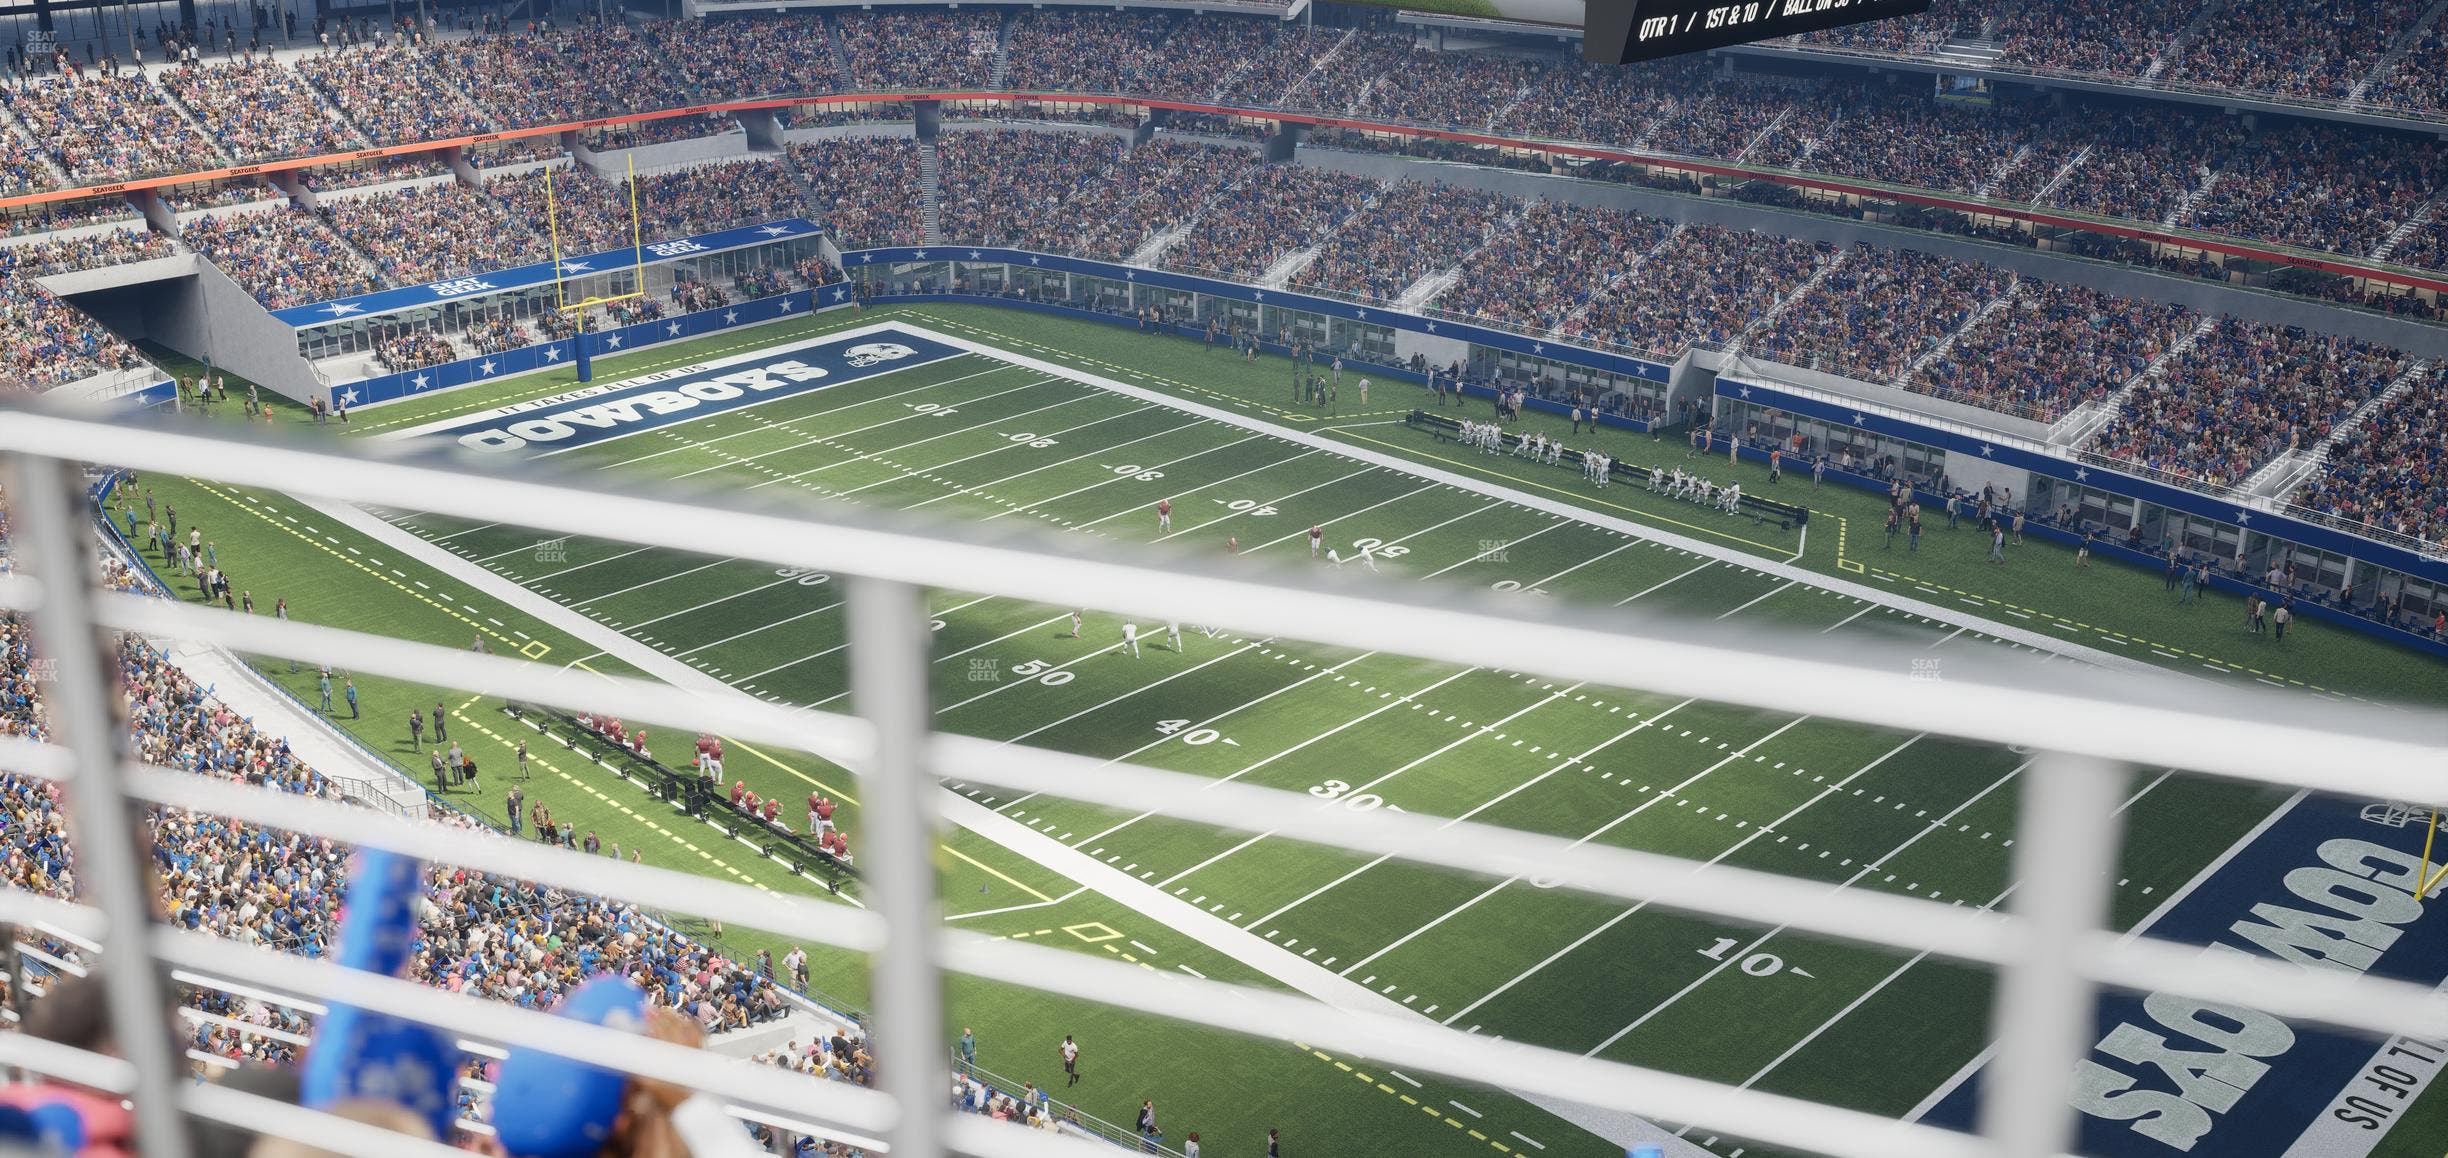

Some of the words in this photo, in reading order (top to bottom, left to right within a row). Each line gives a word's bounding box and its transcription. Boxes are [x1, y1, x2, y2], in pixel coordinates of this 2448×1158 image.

[1639, 16, 1668, 41] QTR
[1669, 14, 1678, 35] 1
[1705, 7, 1729, 29] 1ST
[1728, 5, 1740, 25] &
[1743, 2, 1759, 23] 10
[1782, 0, 1813, 16] BALL
[473, 134, 500, 143] SEATGEEK
[356, 150, 384, 158] SEATGEEK
[230, 166, 260, 176] SEATGEEK
[92, 184, 126, 194] SEATGEEK
[646, 239, 692, 252] SEAT
[656, 243, 711, 256] GEEK
[2287, 256, 2324, 269] SEATGEEK
[428, 277, 480, 291] SEAT
[437, 282, 498, 296] GEEK
[497, 406, 521, 415] IT
[531, 389, 599, 408] TAKES
[604, 380, 640, 392] ALL
[648, 372, 672, 382] OF
[680, 364, 708, 374] US
[457, 360, 829, 453] COWBOYS
[913, 403, 959, 417] 10
[1009, 432, 1060, 448] 20
[1113, 464, 1165, 482] 30
[1226, 499, 1279, 517] 40
[1352, 537, 1411, 559] 50
[1011, 659, 1075, 686] 50
[1154, 718, 1220, 746] 40
[1309, 779, 1383, 813] 30
[1696, 936, 1783, 977] 10
[2066, 838, 2448, 1153] COWOYS
[2387, 1035, 2447, 1064] LL
[2364, 1065, 2418, 1099] OF
[2334, 1096, 2393, 1130] US
